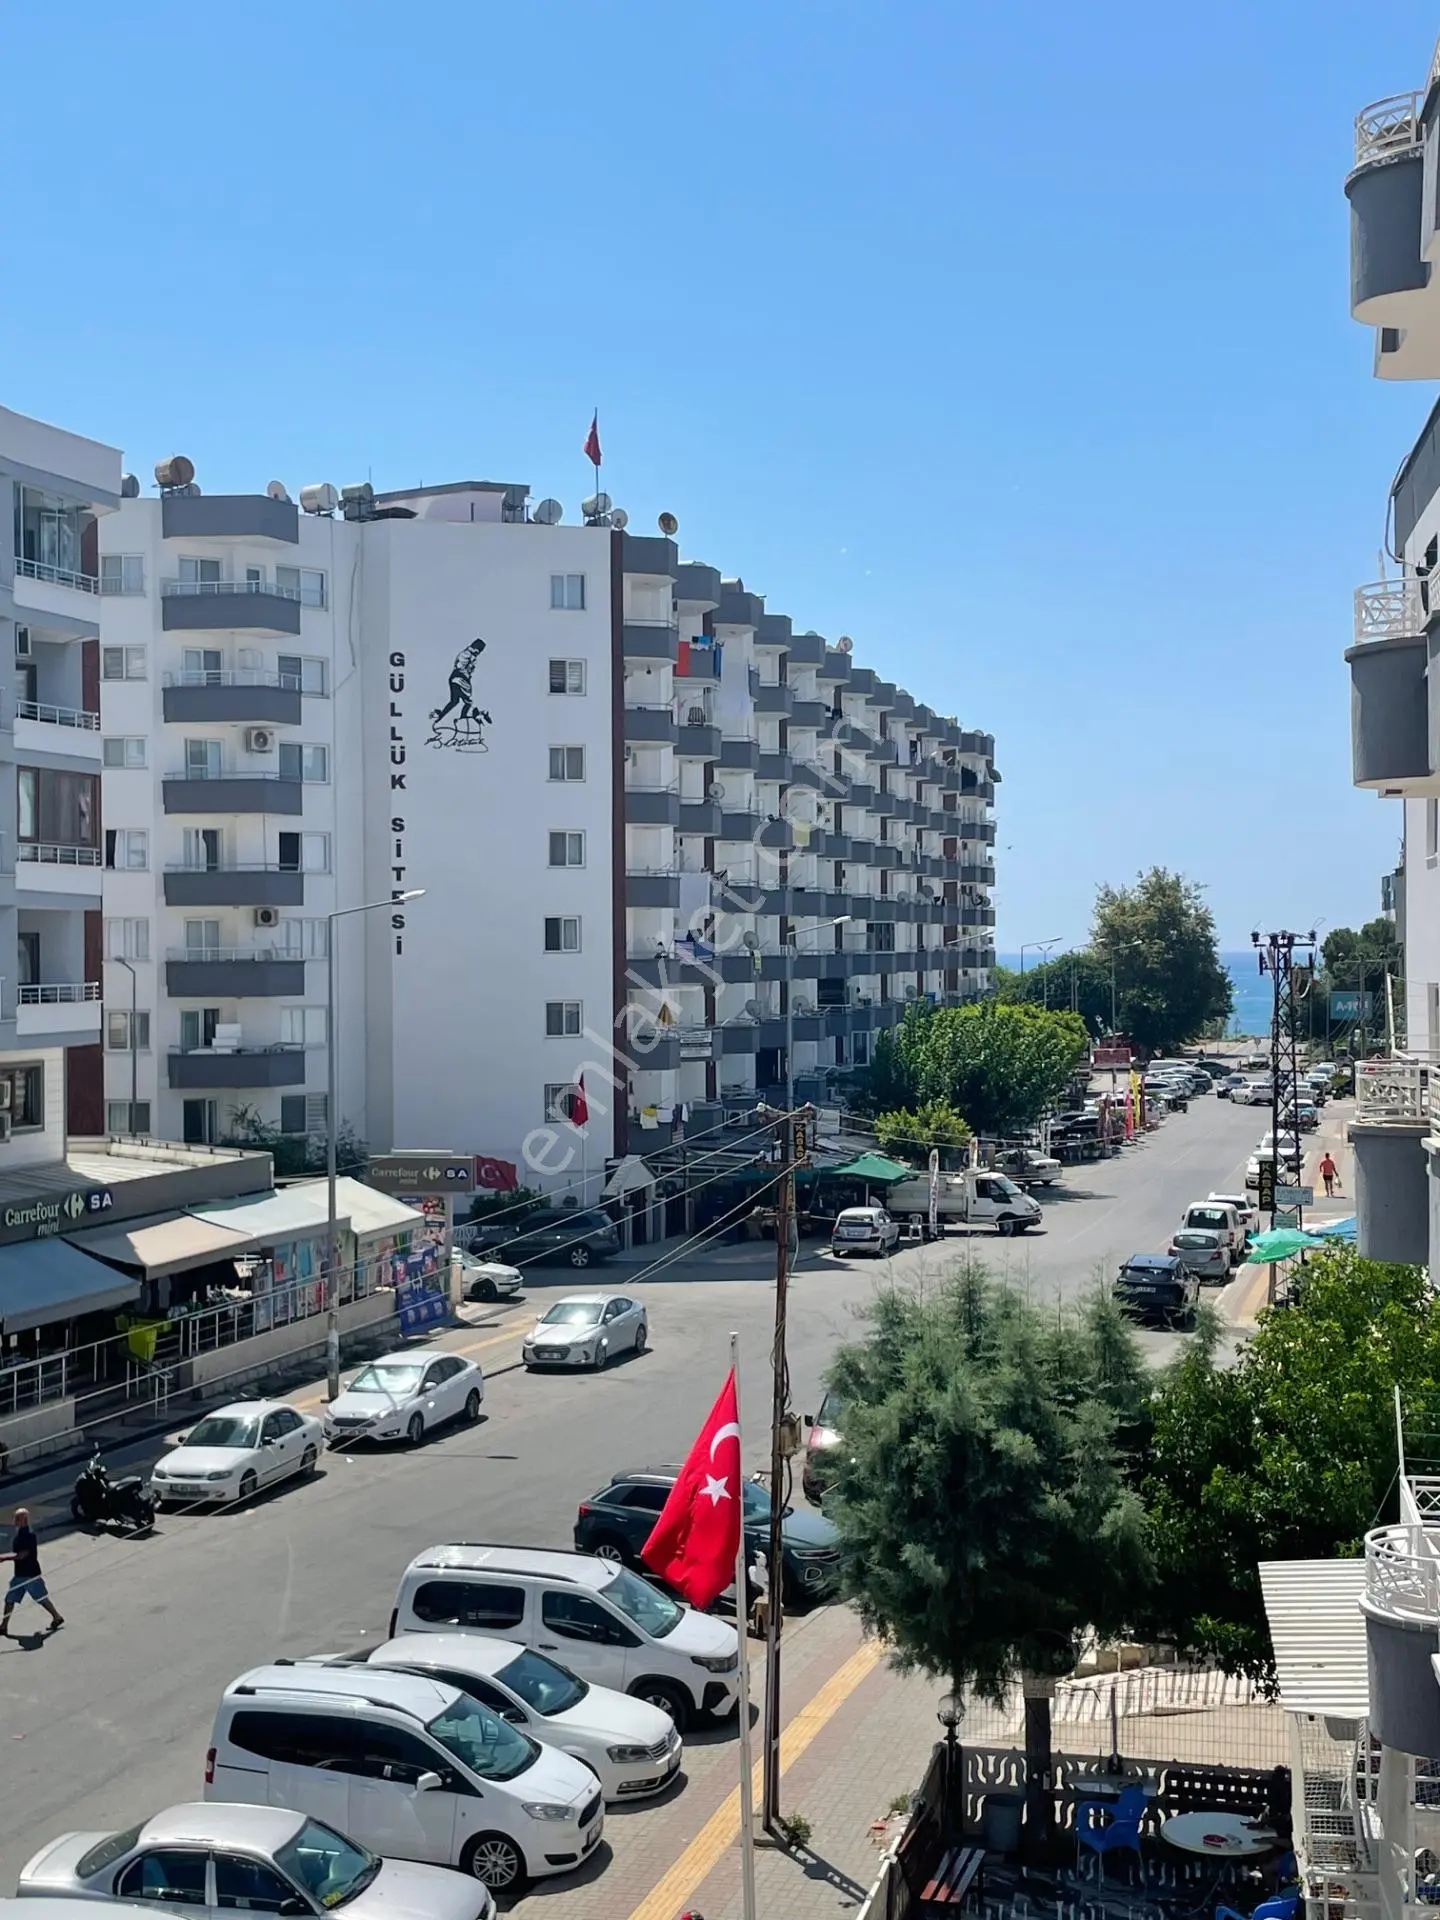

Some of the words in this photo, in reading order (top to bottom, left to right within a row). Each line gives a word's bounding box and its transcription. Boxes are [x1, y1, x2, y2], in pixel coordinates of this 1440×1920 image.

[389, 652, 407, 790] GÜLLÜK
[371, 1167, 419, 1178] Carrefour
[446, 1168, 468, 1179] SA
[5, 1201, 61, 1227] Carrefour
[90, 1192, 113, 1210] SA
[37, 1219, 60, 1236] mini
